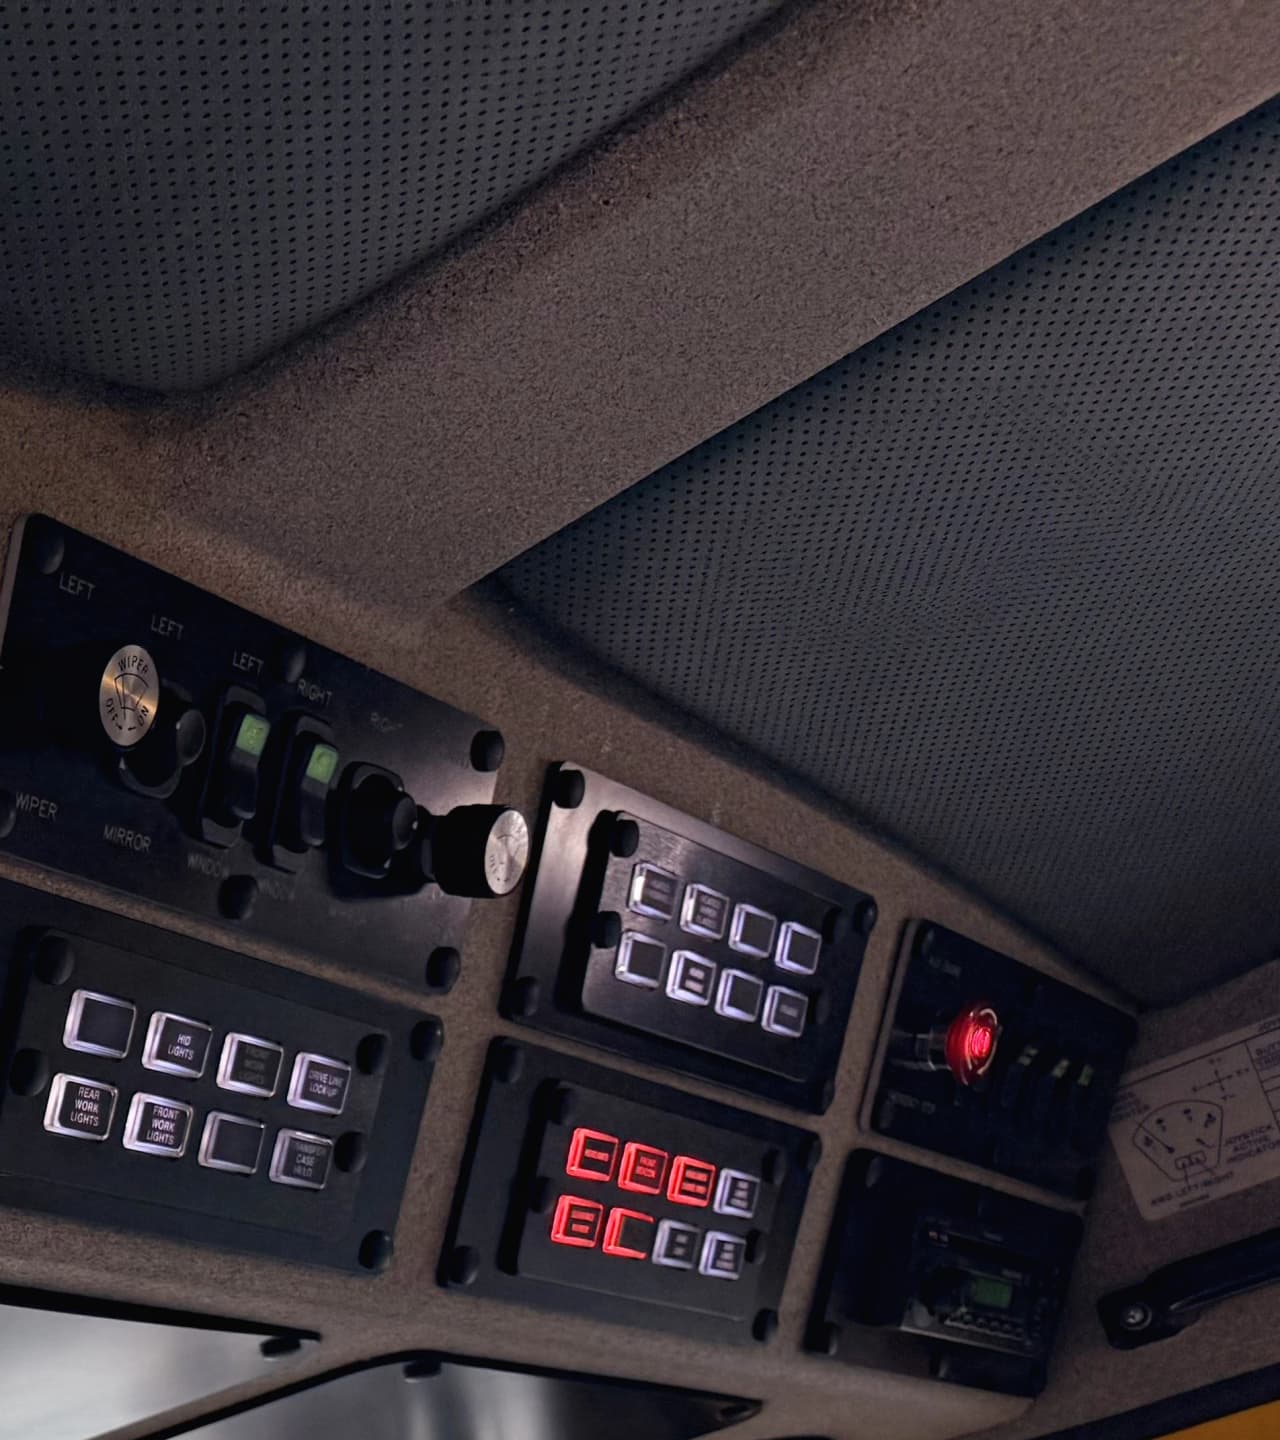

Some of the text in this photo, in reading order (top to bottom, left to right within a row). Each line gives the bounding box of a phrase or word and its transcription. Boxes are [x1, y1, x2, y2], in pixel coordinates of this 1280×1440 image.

[58, 573, 96, 600] LEFT
[150, 613, 185, 640] LEFT
[118, 655, 149, 675] WIPER
[232, 649, 264, 675] LEFT
[297, 679, 333, 706] RIGHT
[137, 705, 150, 727] ON
[15, 791, 58, 821] WIPER
[103, 824, 151, 853] MIRROR
[177, 1033, 192, 1046] HID
[168, 1044, 194, 1060] LIGHTS
[78, 1086, 100, 1100] REAR
[75, 1099, 99, 1114] WORK
[152, 1105, 179, 1120] FRONT
[70, 1111, 99, 1126] LIGHTS
[151, 1118, 176, 1132] WORK
[146, 1130, 175, 1145] LIGHTS
